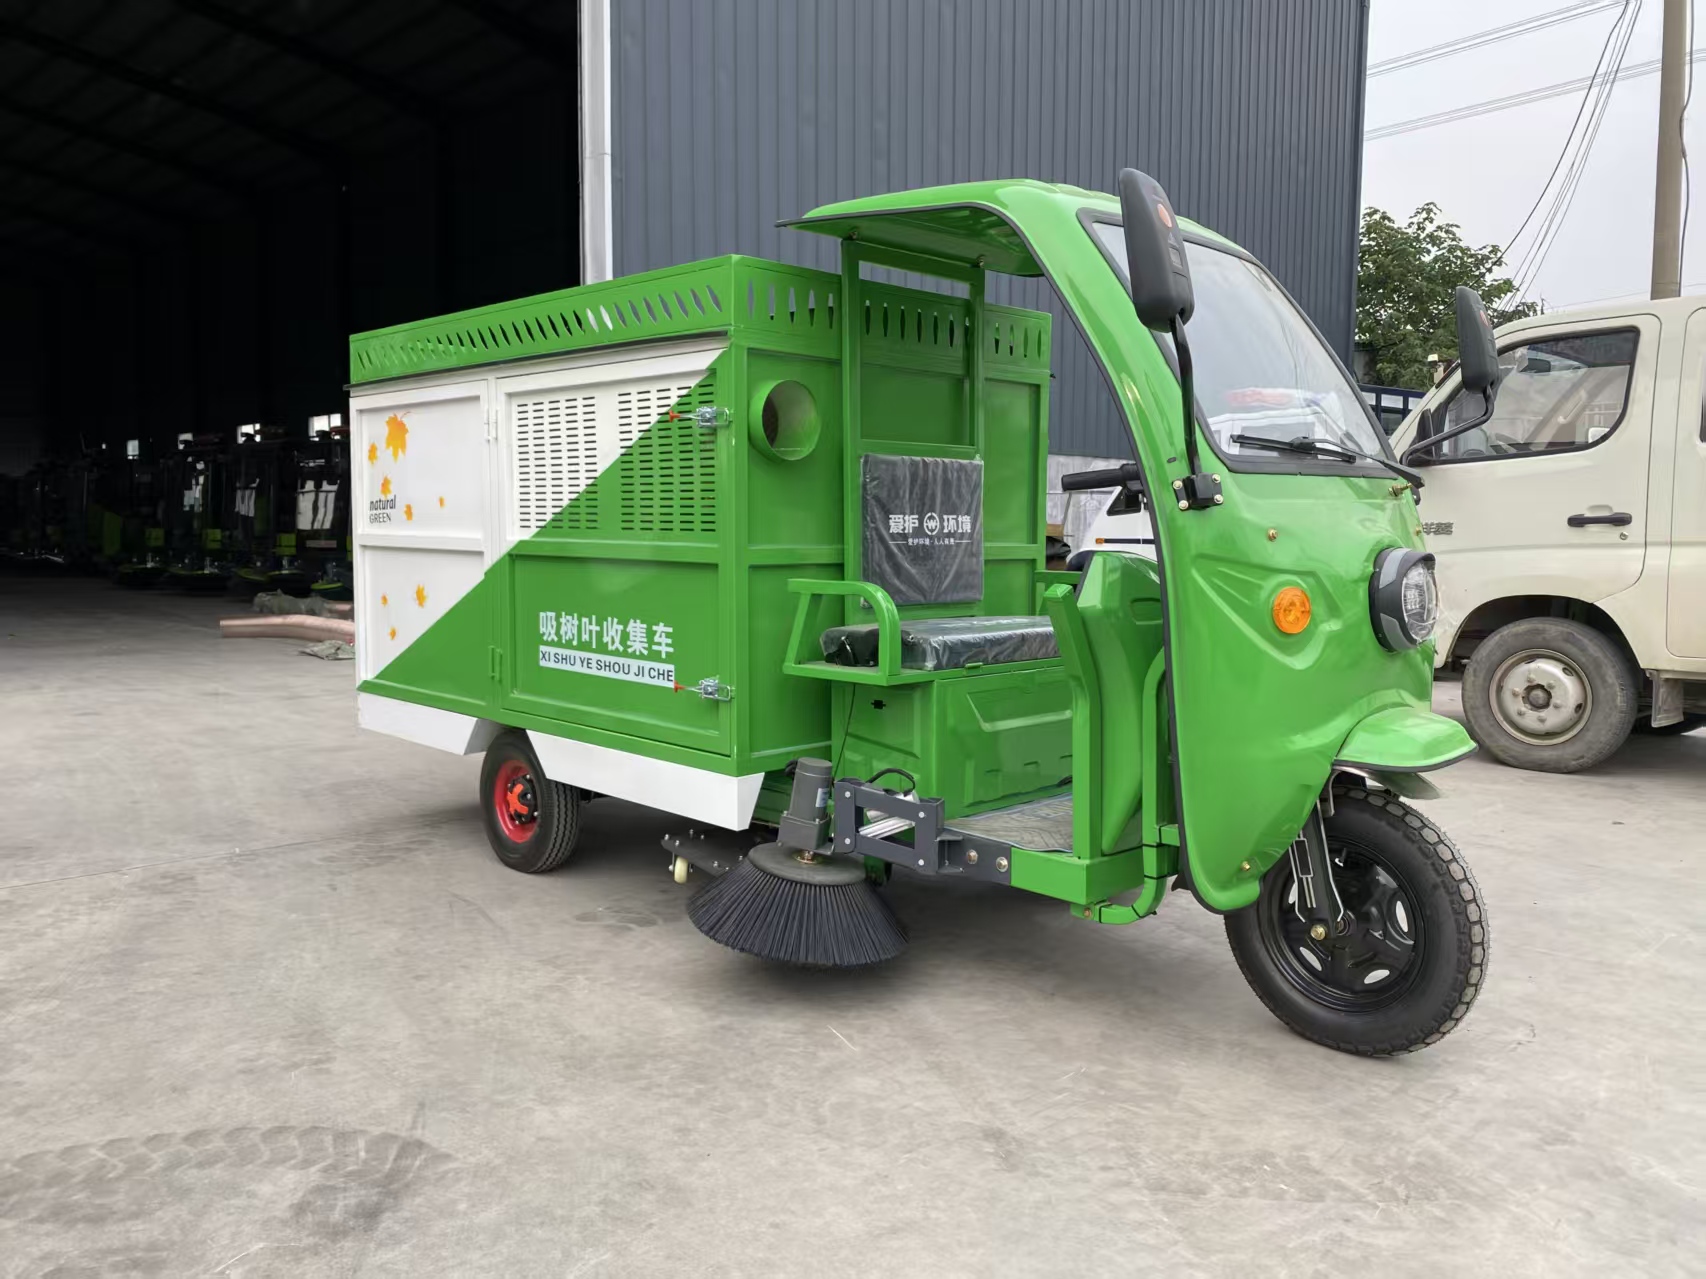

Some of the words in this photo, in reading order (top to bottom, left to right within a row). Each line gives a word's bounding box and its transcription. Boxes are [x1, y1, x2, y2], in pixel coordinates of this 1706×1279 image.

[370, 494, 396, 511] natural
[369, 512, 392, 524] GREEN
[889, 514, 919, 533] 爱护
[943, 514, 972, 533] 环境
[539, 611, 675, 659] 吸树叶收集车
[540, 650, 551, 663] XI
[553, 652, 577, 667] SHU
[579, 656, 593, 670] YE
[595, 659, 631, 675] SHOU
[634, 665, 645, 678] JI
[648, 667, 674, 682] CHE
